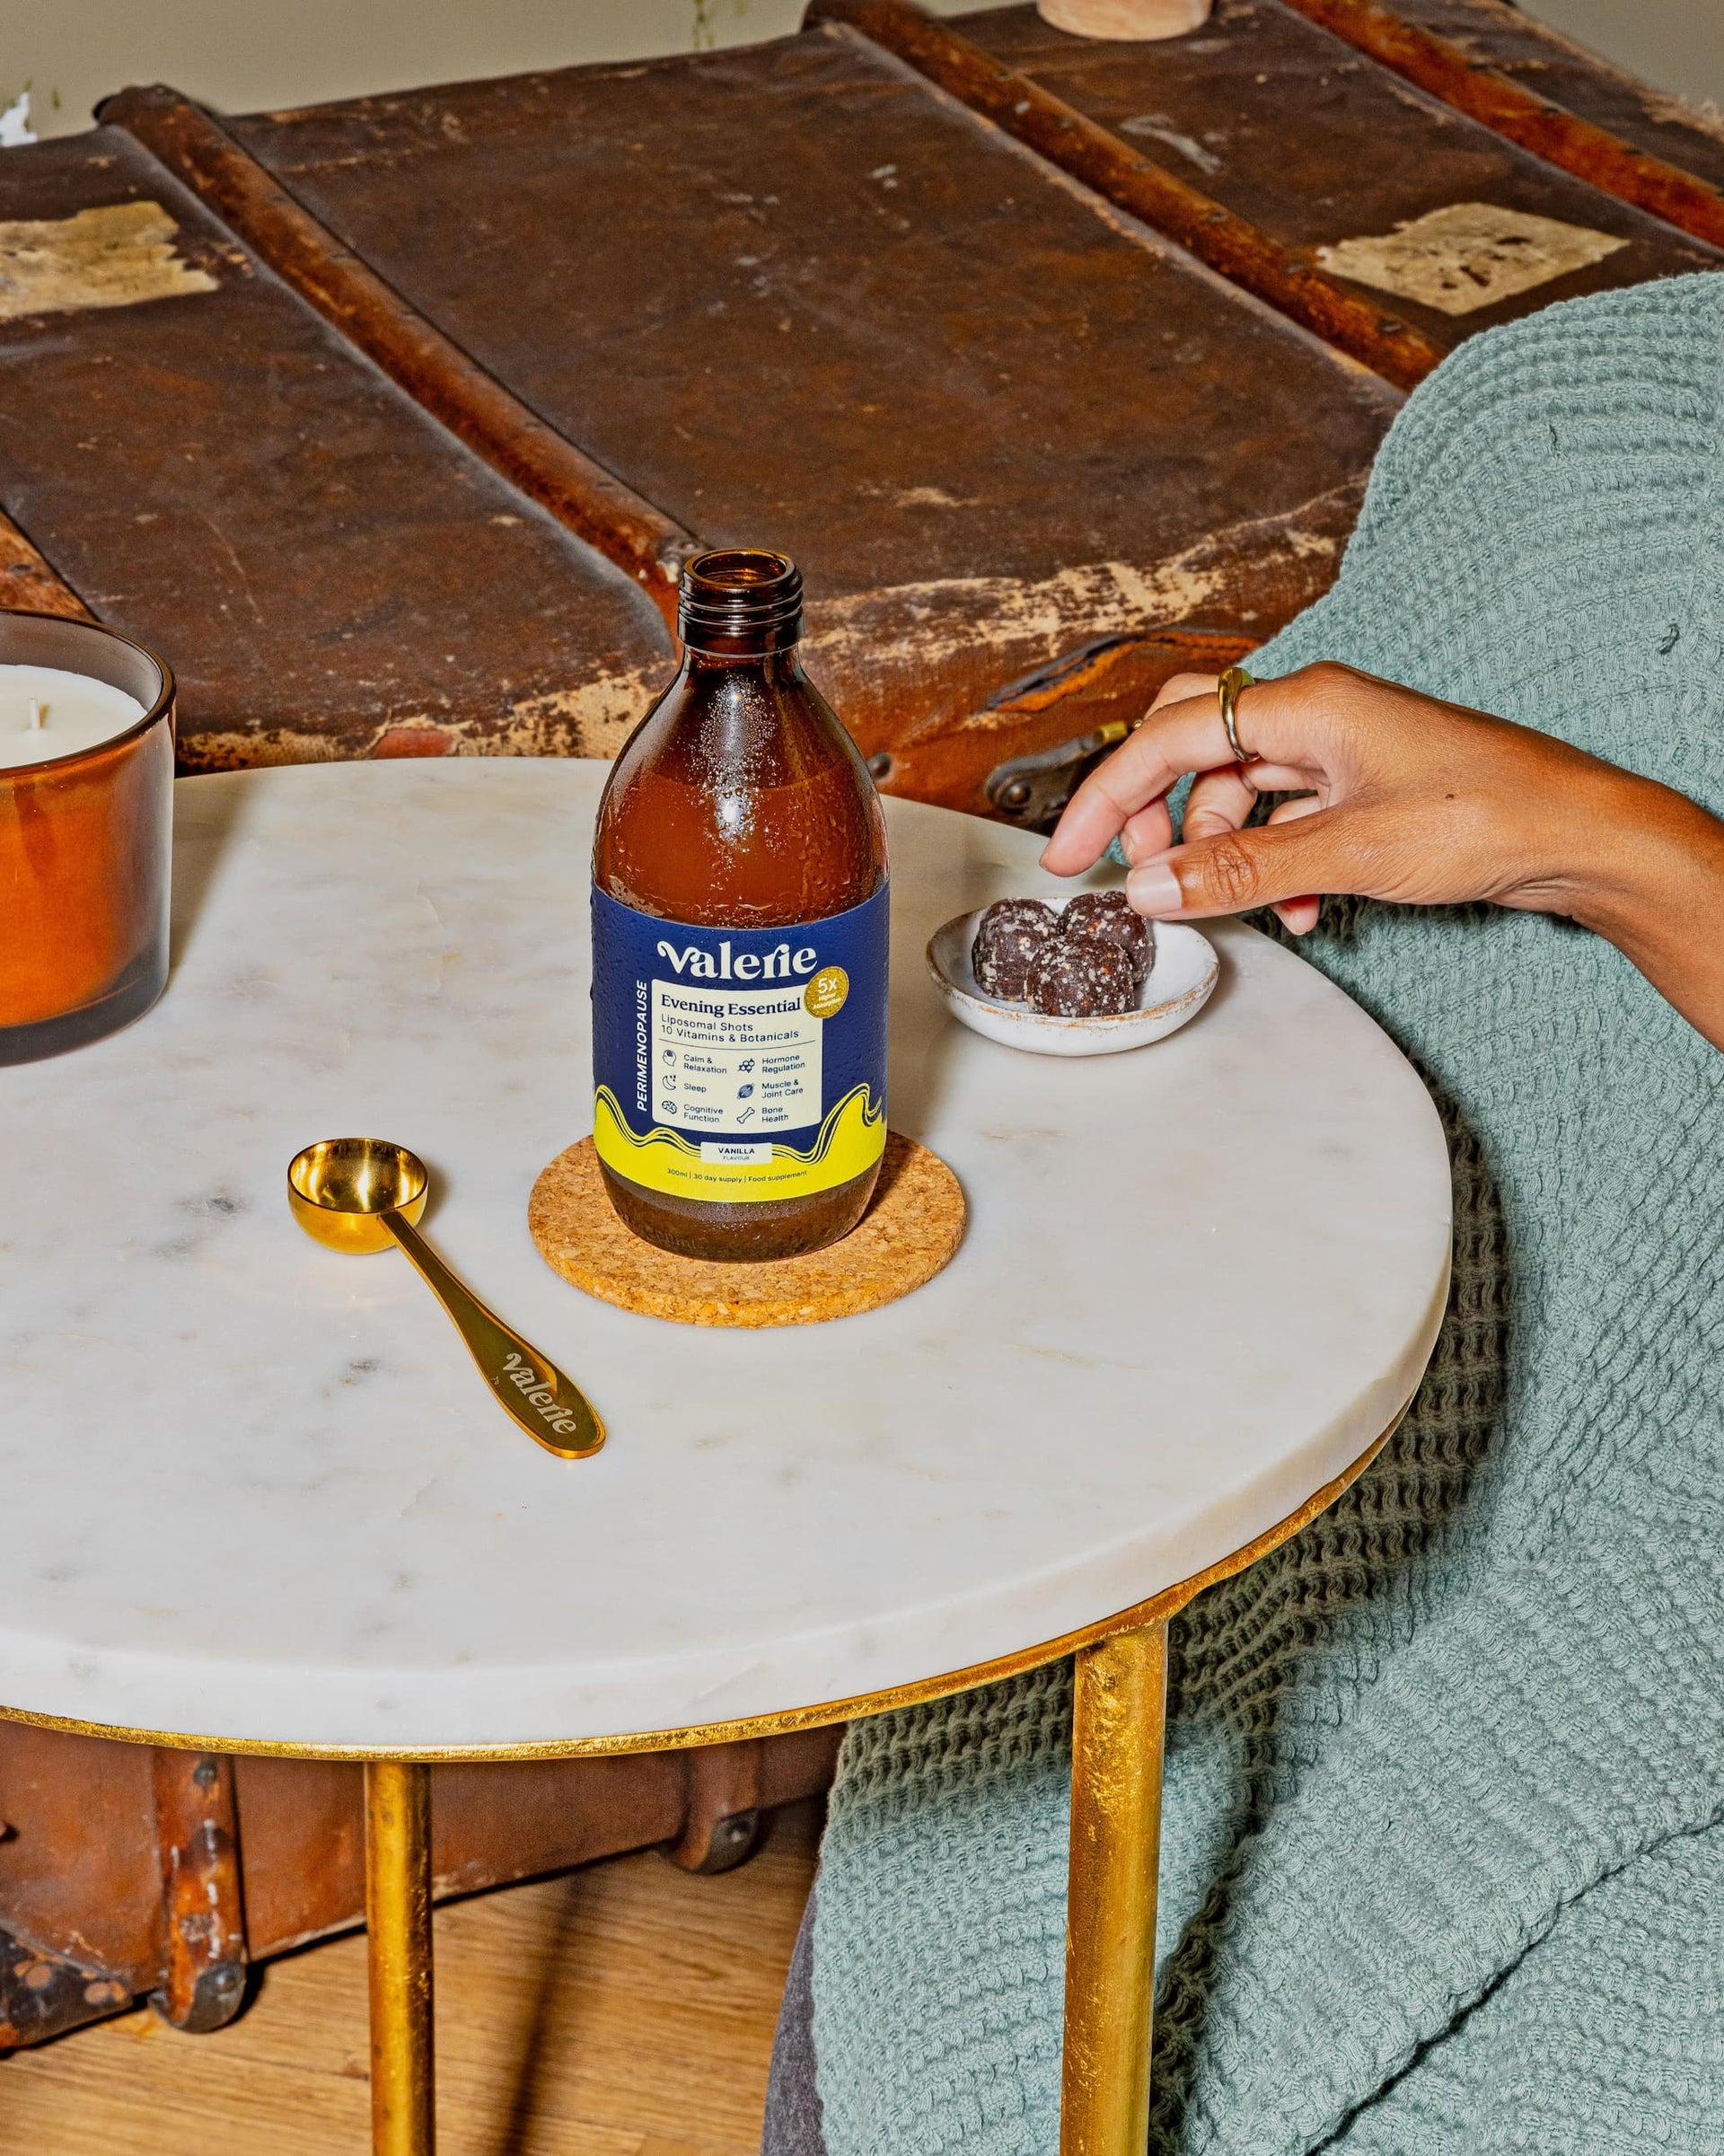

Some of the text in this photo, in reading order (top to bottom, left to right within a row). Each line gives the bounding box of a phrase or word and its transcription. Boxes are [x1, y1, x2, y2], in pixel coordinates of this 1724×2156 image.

[656, 940, 818, 981] Valerie
[818, 977, 838, 994] 5x
[661, 994, 725, 1018] Evening
[728, 997, 801, 1016] Essential
[661, 1014, 753, 1032] Liposomal Shots
[661, 1025, 799, 1043] 10 Vitamins & Botanicals
[637, 980, 647, 1113] PERIMENOPAUSE
[683, 1053, 705, 1063] Calm
[761, 1054, 800, 1064] Hormone
[683, 1062, 727, 1074] Relaxation
[761, 1061, 805, 1074] Regulation
[683, 1083, 707, 1093] Sleep
[761, 1080, 792, 1090] Muscle
[761, 1087, 804, 1099] Joint Care
[683, 1104, 724, 1115] Cognitive
[761, 1106, 783, 1114] Bone
[683, 1112, 720, 1122] Function
[761, 1113, 789, 1122] Health
[717, 1147, 755, 1155] VANILLA
[666, 1168, 688, 1177] 300ml
[704, 1175, 717, 1183] day
[768, 1170, 807, 1182] supplement
[502, 1352, 576, 1434] Valerie
